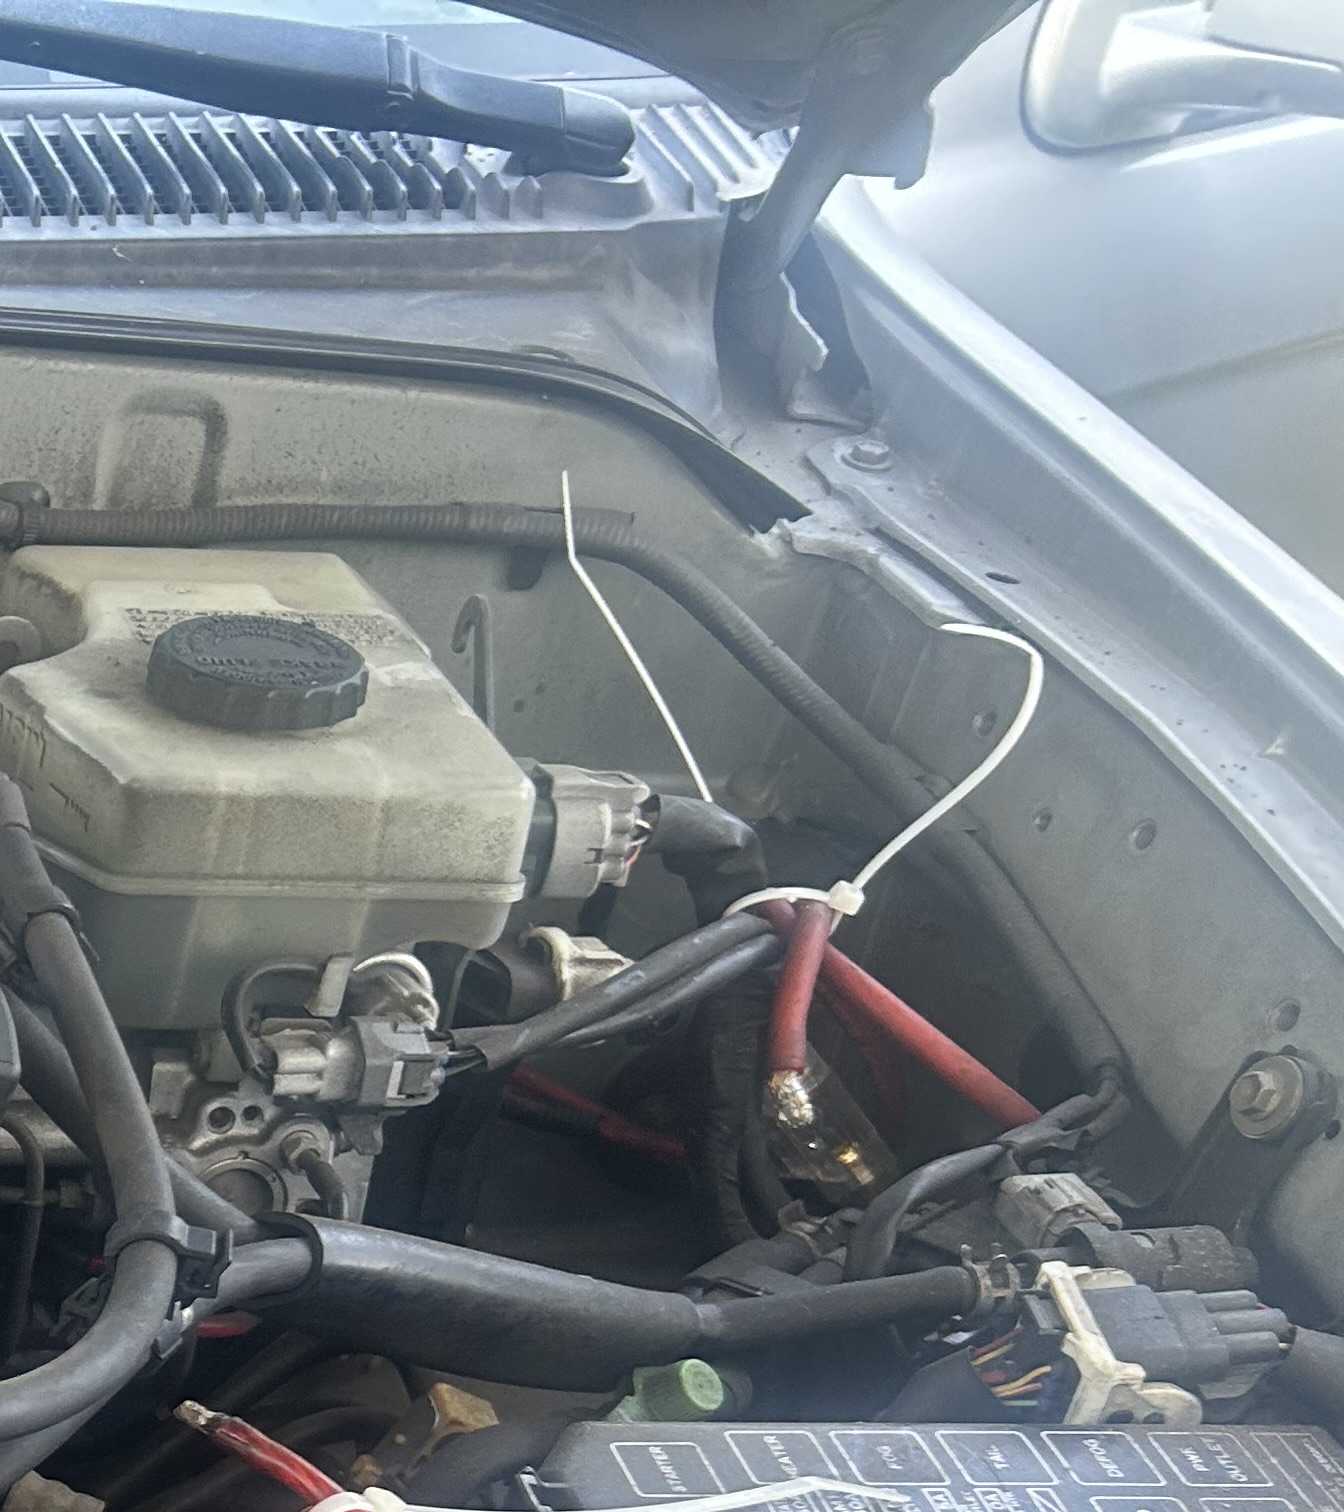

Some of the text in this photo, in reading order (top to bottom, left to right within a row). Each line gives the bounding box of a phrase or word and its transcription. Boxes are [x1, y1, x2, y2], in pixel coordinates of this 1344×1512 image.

[647, 1446, 687, 1492] STARTER
[876, 1445, 902, 1469] FOG
[984, 1445, 1009, 1469] TAIL
[1084, 1438, 1122, 1477] DEFOG
[1201, 1437, 1247, 1481] OUTLET
